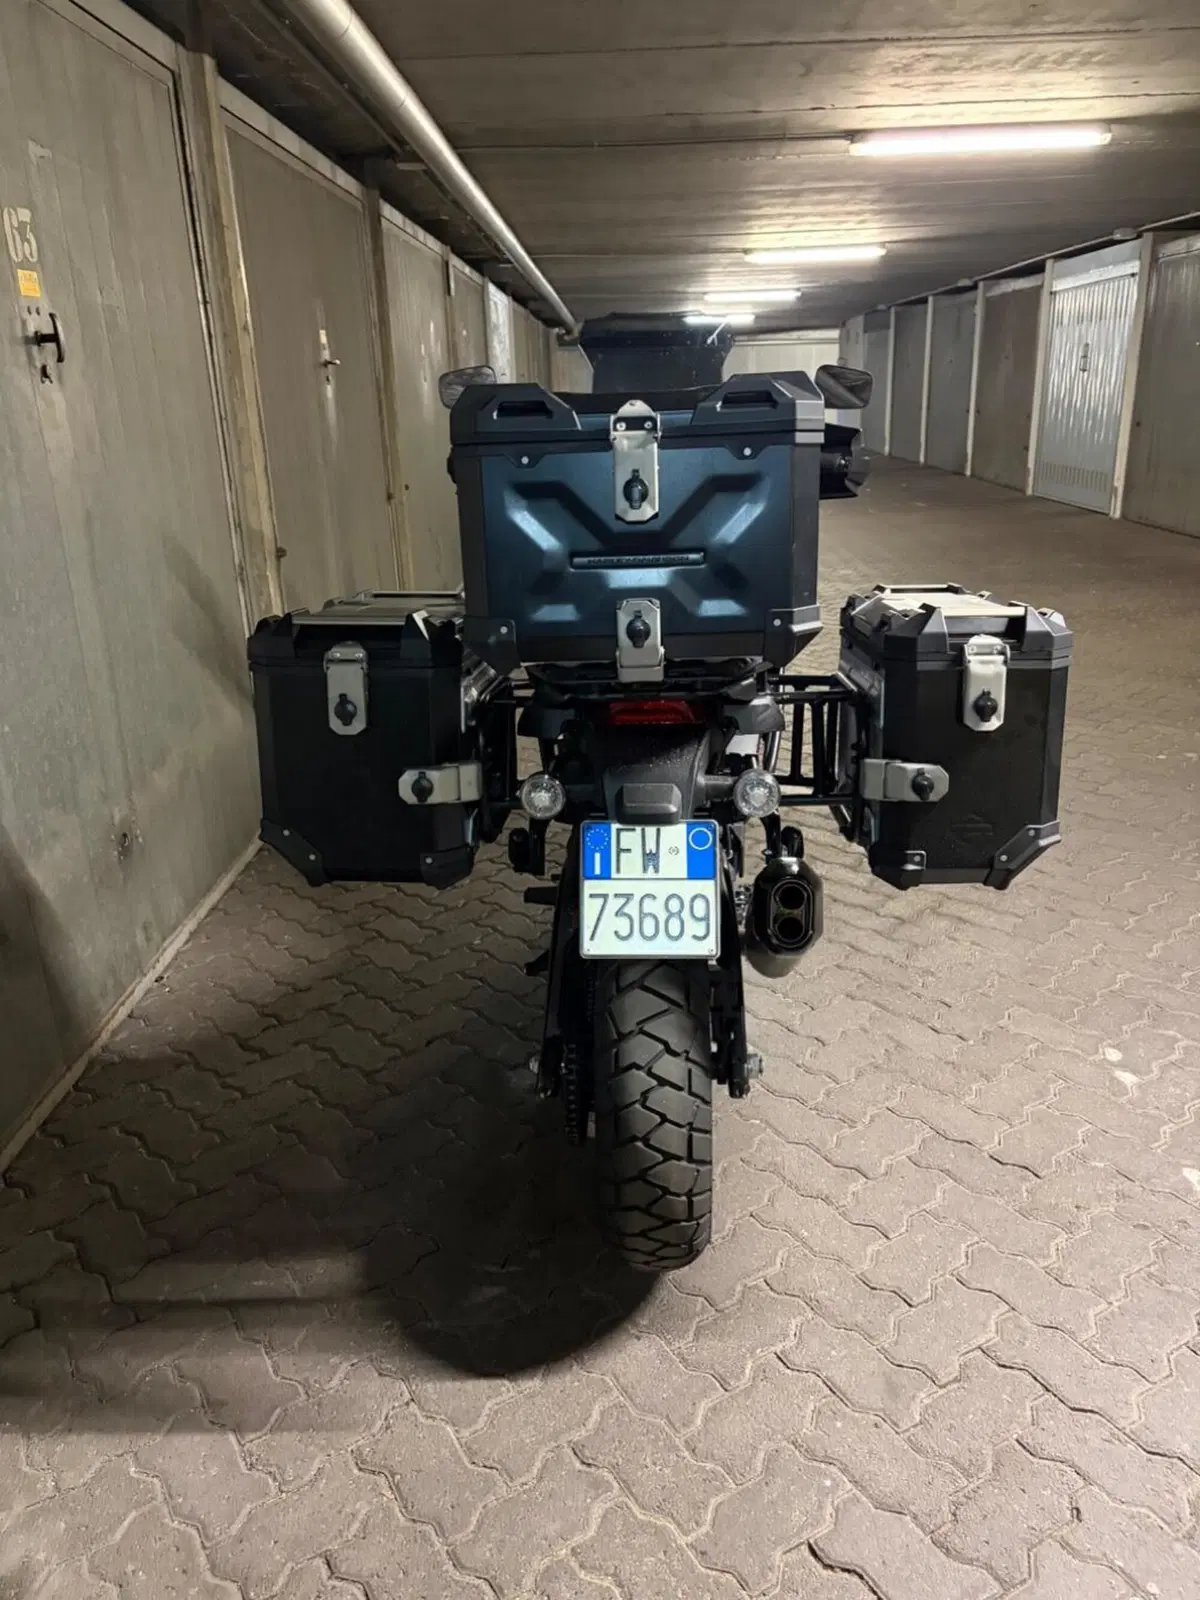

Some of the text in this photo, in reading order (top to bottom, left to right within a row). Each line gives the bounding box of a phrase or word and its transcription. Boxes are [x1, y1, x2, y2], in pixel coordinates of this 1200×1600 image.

[3, 206, 38, 263] 63
[615, 827, 661, 874] FW
[588, 892, 710, 942] 73689
